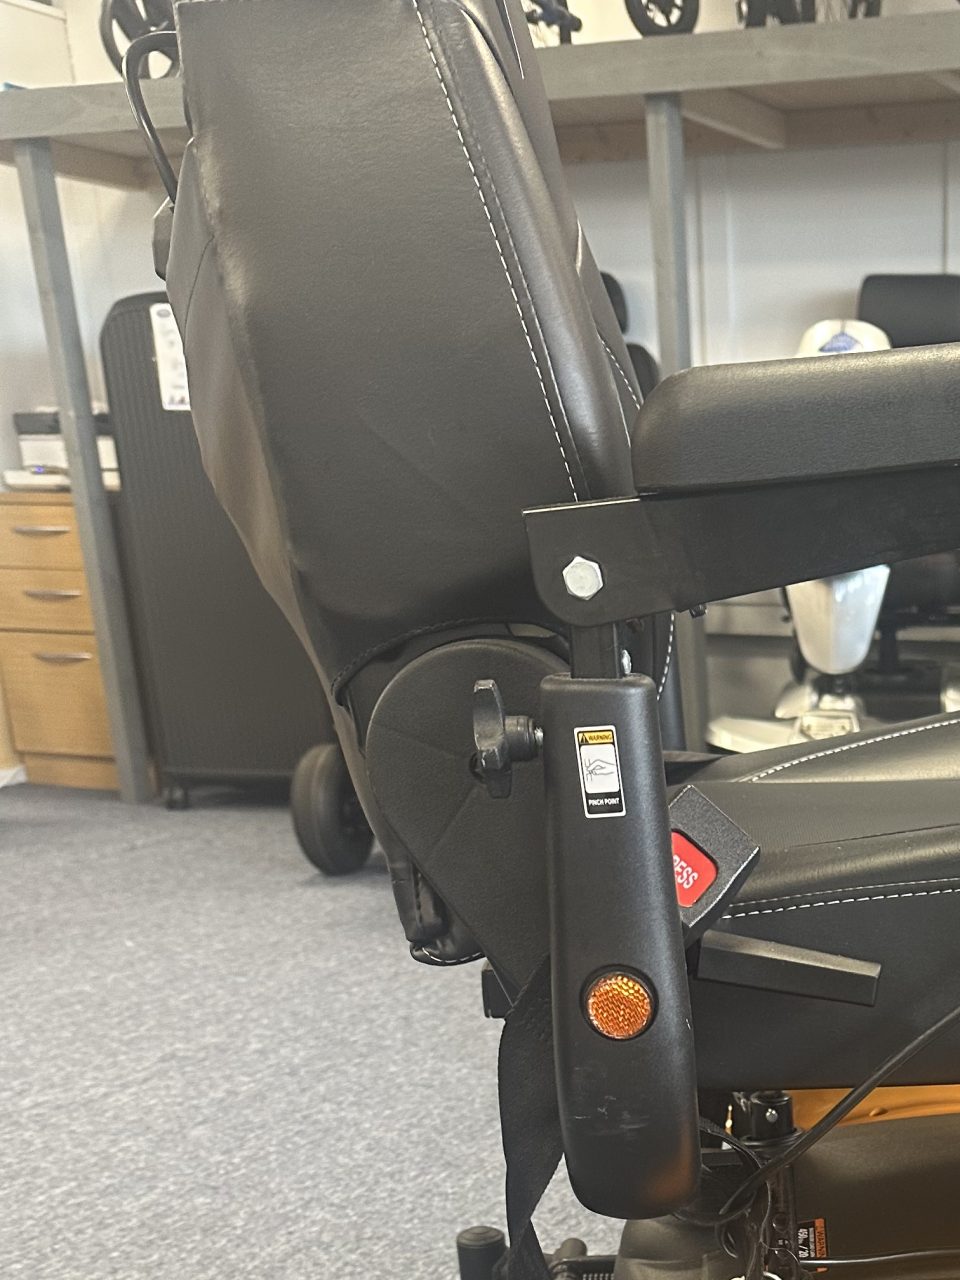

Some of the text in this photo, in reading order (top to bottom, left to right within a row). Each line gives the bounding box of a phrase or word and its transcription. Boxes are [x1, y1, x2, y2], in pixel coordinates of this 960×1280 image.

[588, 733, 612, 742] WARNING
[588, 797, 620, 807] PINCH POINT
